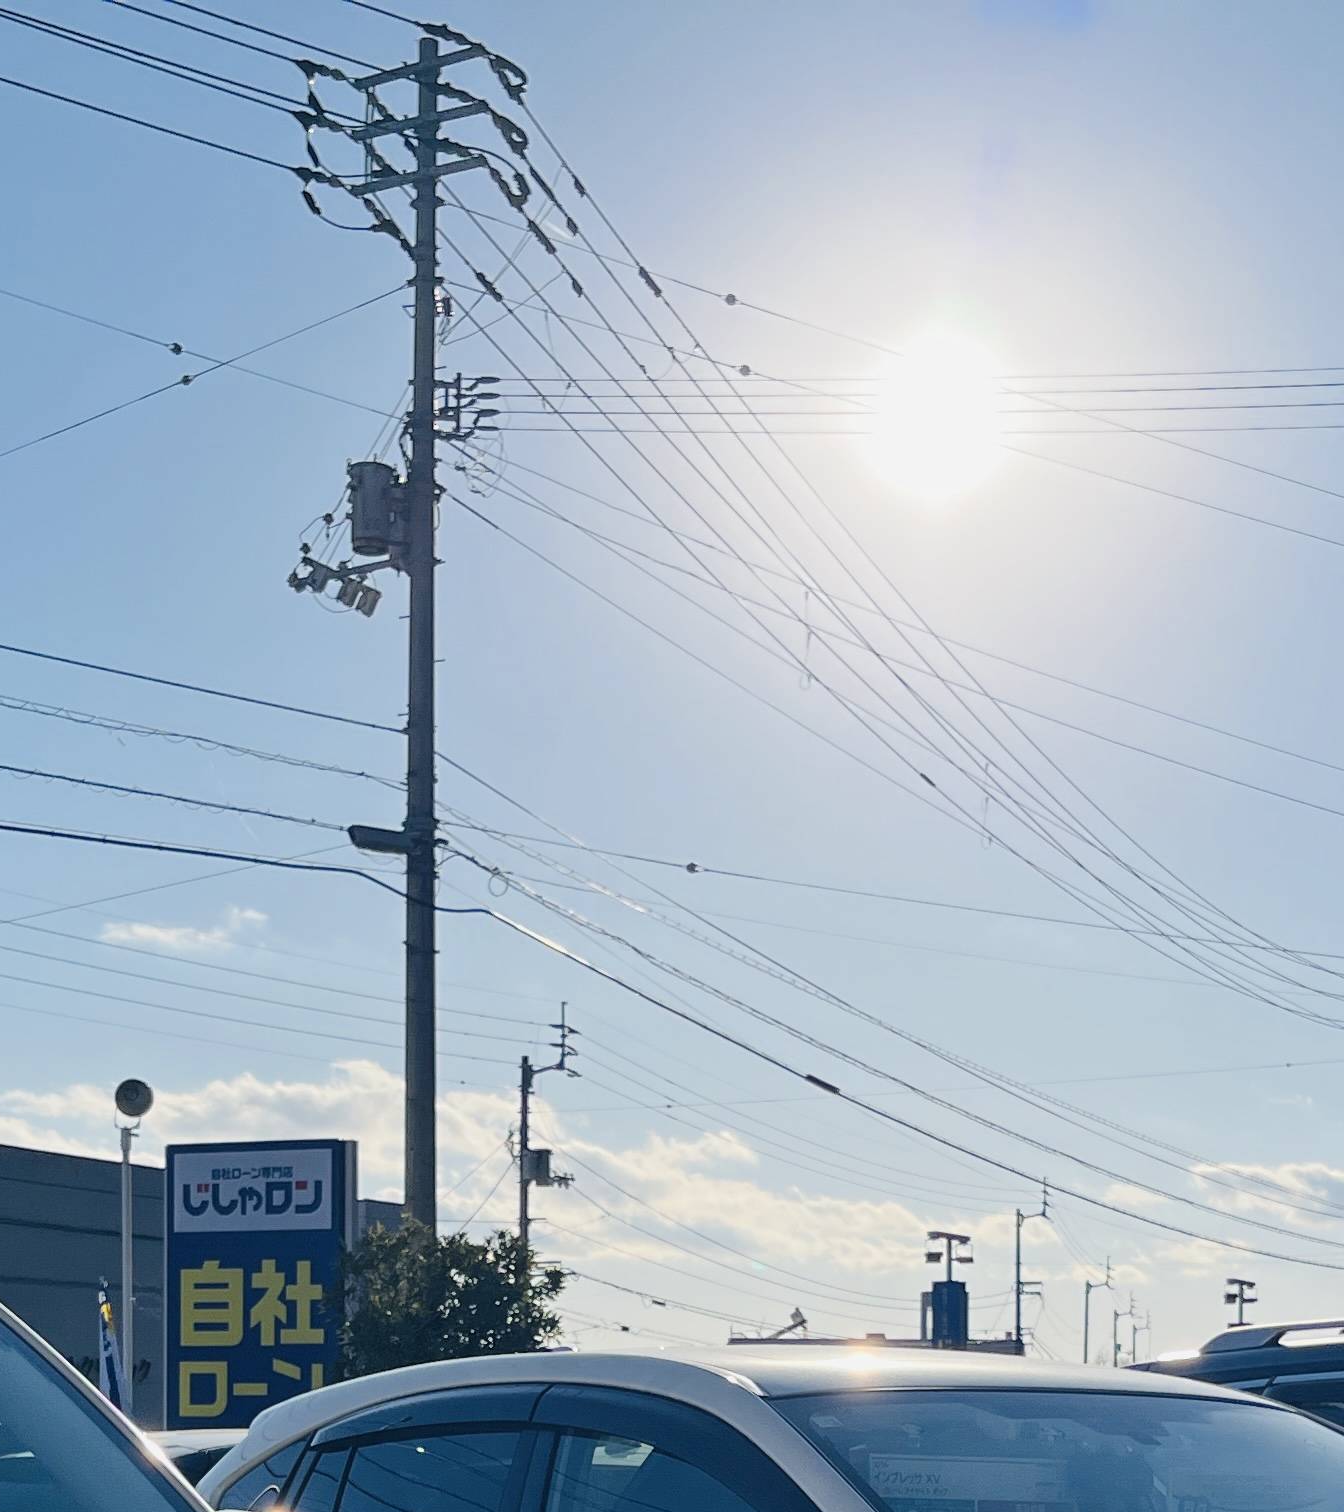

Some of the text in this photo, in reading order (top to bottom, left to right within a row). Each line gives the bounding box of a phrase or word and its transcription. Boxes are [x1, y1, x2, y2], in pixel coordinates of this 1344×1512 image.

[211, 1166, 294, 1180] 自社ローン専門店
[179, 1259, 325, 1347] 自社
